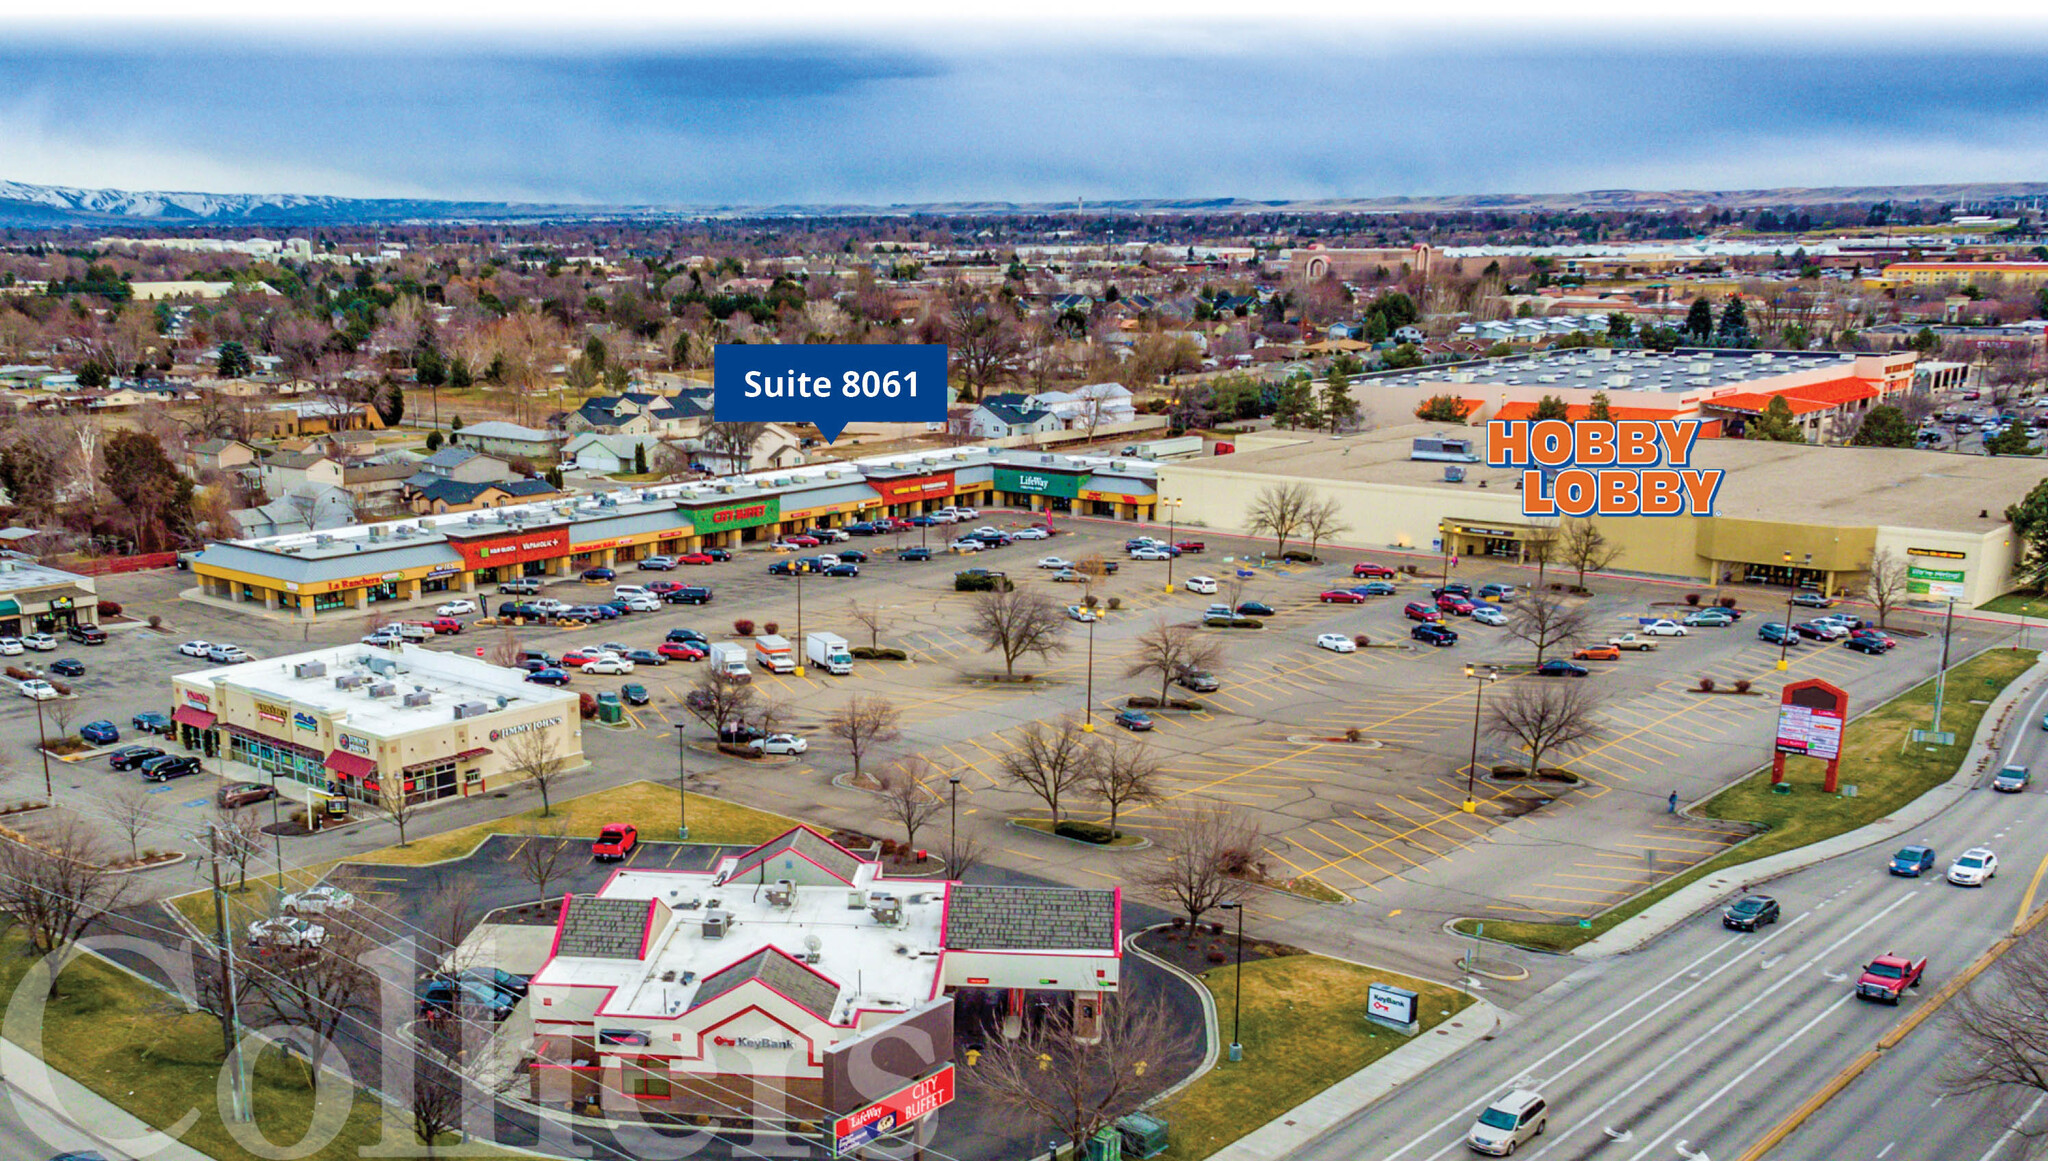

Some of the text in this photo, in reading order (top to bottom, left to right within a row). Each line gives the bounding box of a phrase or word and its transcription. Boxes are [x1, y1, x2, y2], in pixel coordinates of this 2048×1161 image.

[1020, 475, 1049, 490] LifeWay
[713, 505, 766, 523] CITY BUFFET
[328, 582, 340, 591] La
[341, 577, 380, 589] Ranchera
[501, 716, 563, 739] JIMMY JOHN'S
[349, 734, 369, 746] JIMMY
[1374, 994, 1405, 1007] KeyBank
[737, 1036, 796, 1050] KeyBank
[912, 1076, 938, 1099] CITY
[905, 1089, 944, 1120] BUFFET
[850, 1106, 883, 1128] LifeWay
